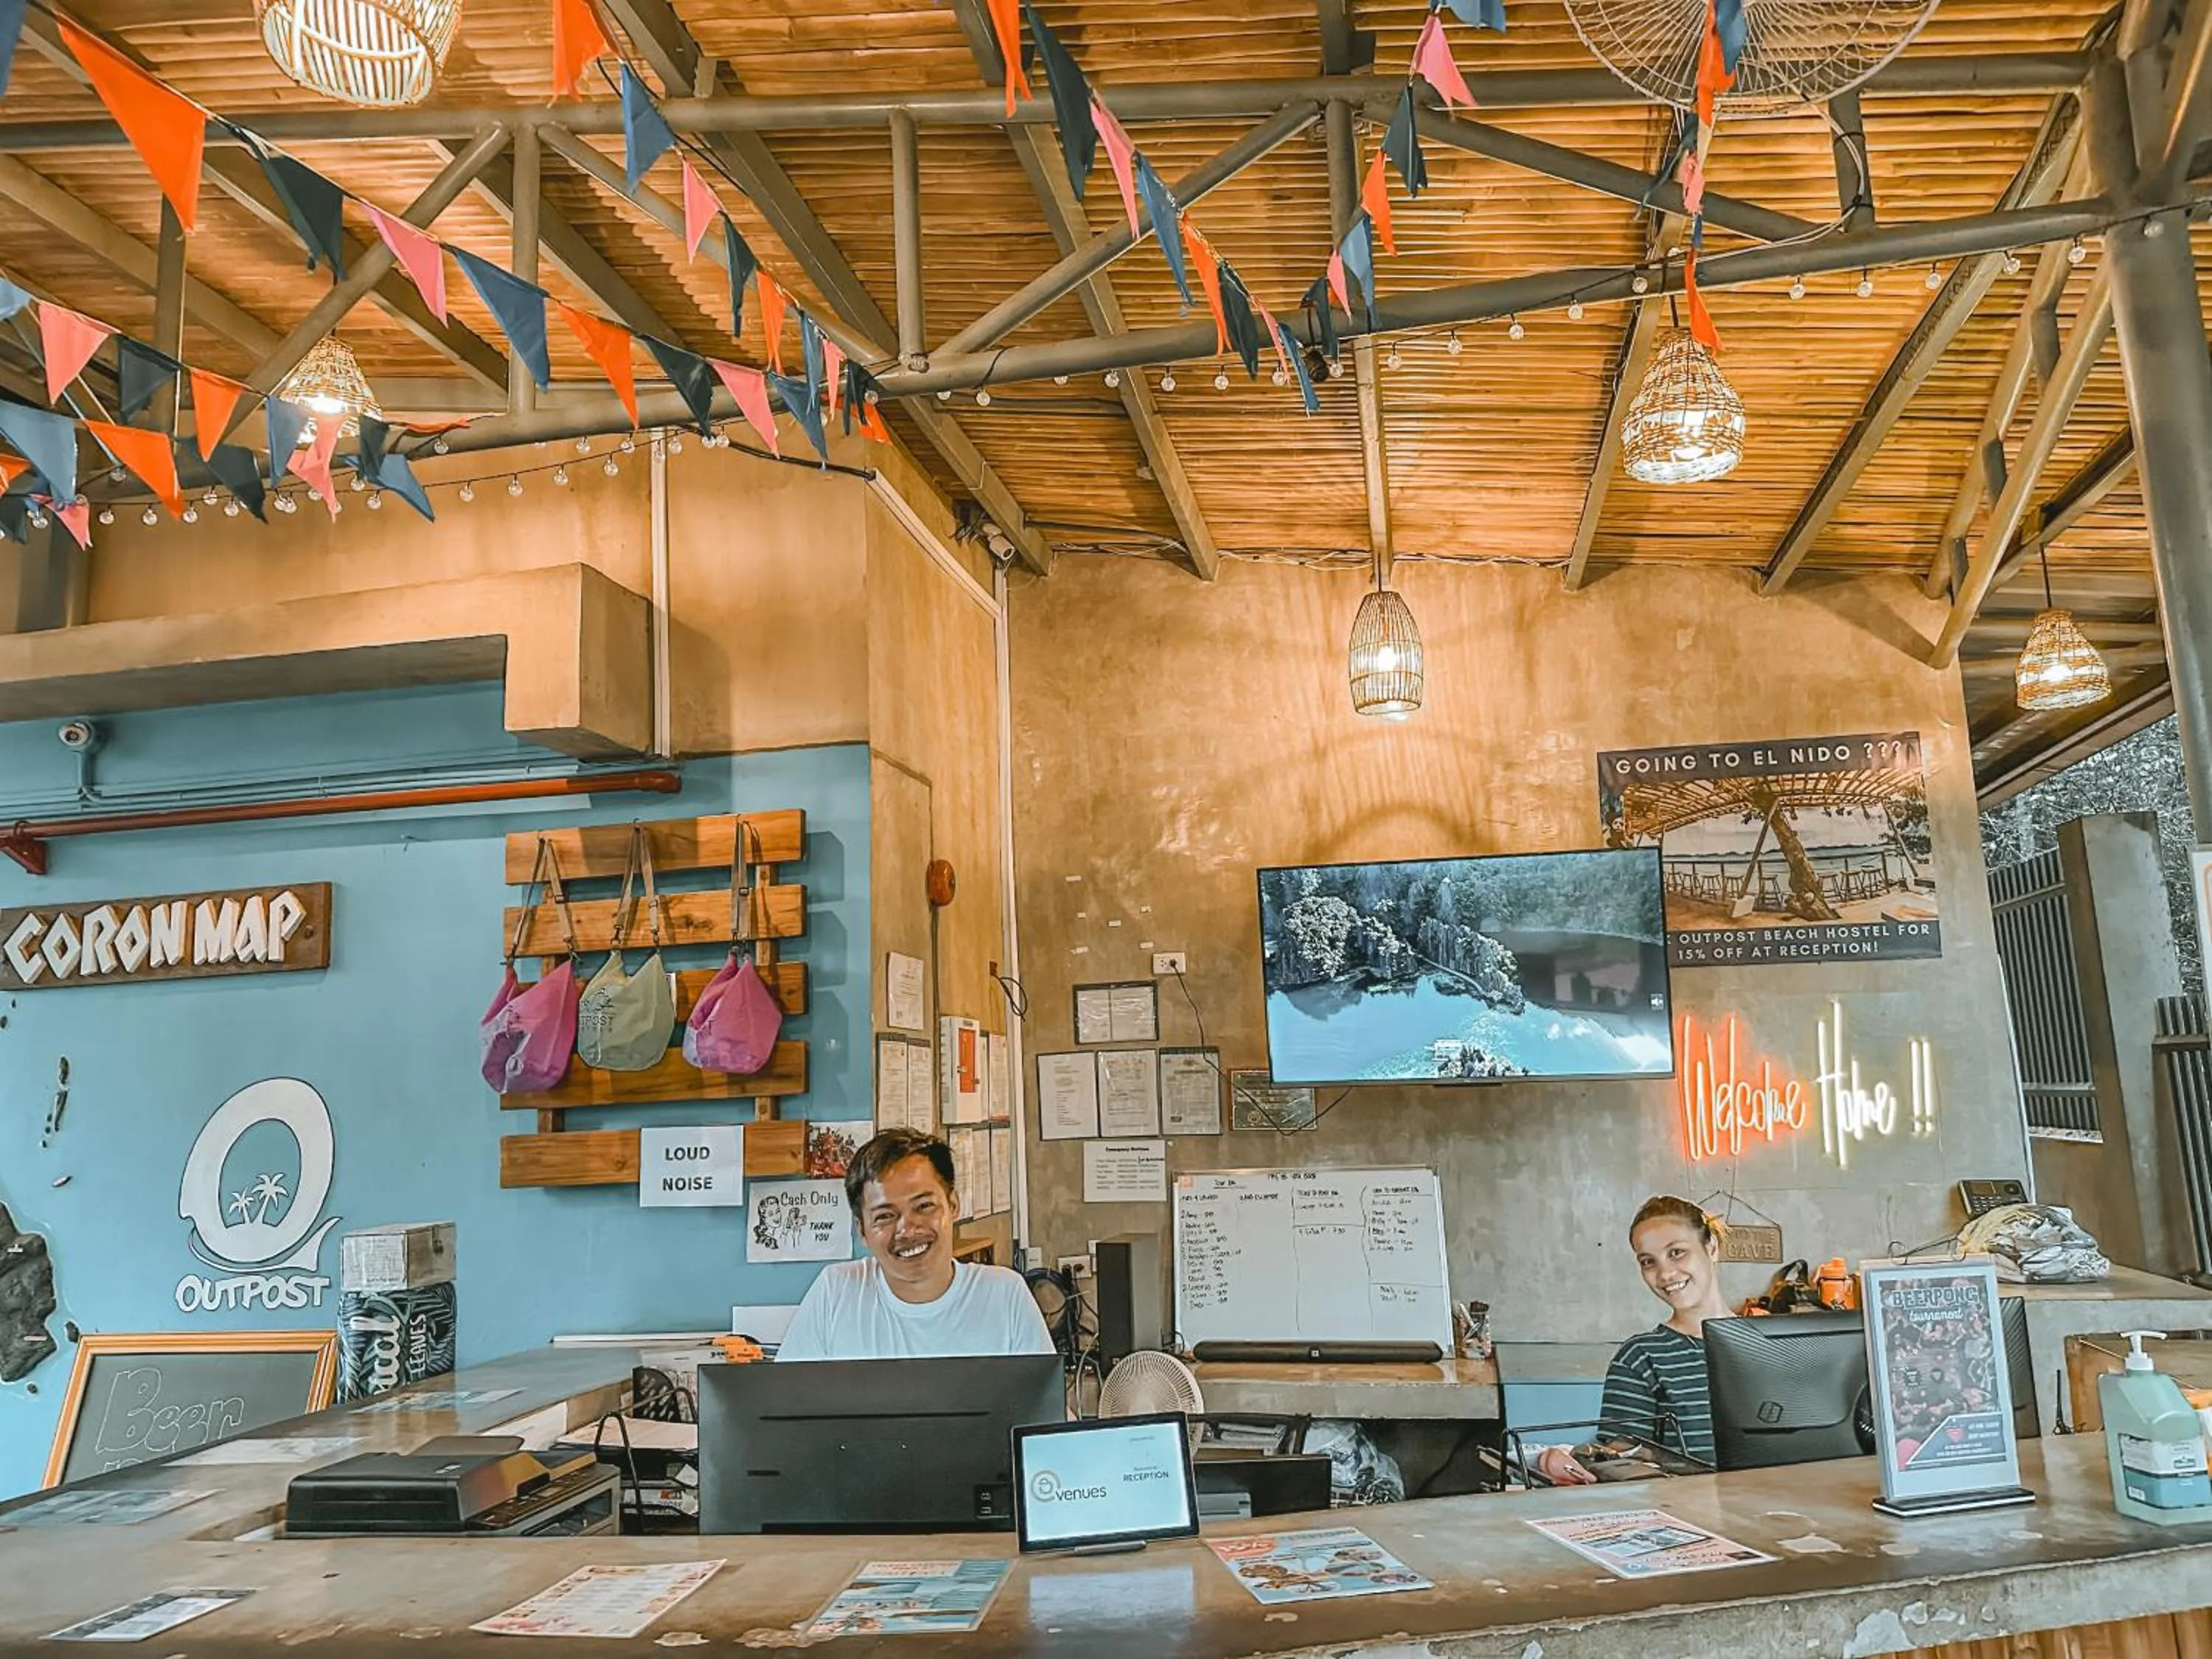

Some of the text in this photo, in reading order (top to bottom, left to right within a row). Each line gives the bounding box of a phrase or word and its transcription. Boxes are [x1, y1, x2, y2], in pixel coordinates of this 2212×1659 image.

[1615, 740, 1902, 774] GOING TO EL NIDO ???
[3, 890, 308, 984] CORON MAP
[1679, 931, 1756, 945] OUTPOST
[1764, 928, 1818, 941] BEACH
[1826, 925, 1890, 939] HOSTEL
[1898, 924, 1930, 936] FOR
[1677, 941, 1880, 960] 15% OFF AT RECEPTION!
[1683, 1015, 1806, 1161] Welcome
[1810, 999, 1897, 1169] Home
[665, 1147, 710, 1161] LOUD
[662, 1177, 713, 1191] NOISE
[781, 1191, 838, 1206] Cash Only
[810, 1221, 835, 1231] THANK
[815, 1233, 830, 1242] YOU
[175, 1274, 331, 1312] OUTPOST
[1892, 1285, 1980, 1310] BEERPONG
[409, 1314, 427, 1372] LEAVES
[94, 1367, 245, 1455] Beer
[1123, 1470, 1169, 1482] RECEPTION
